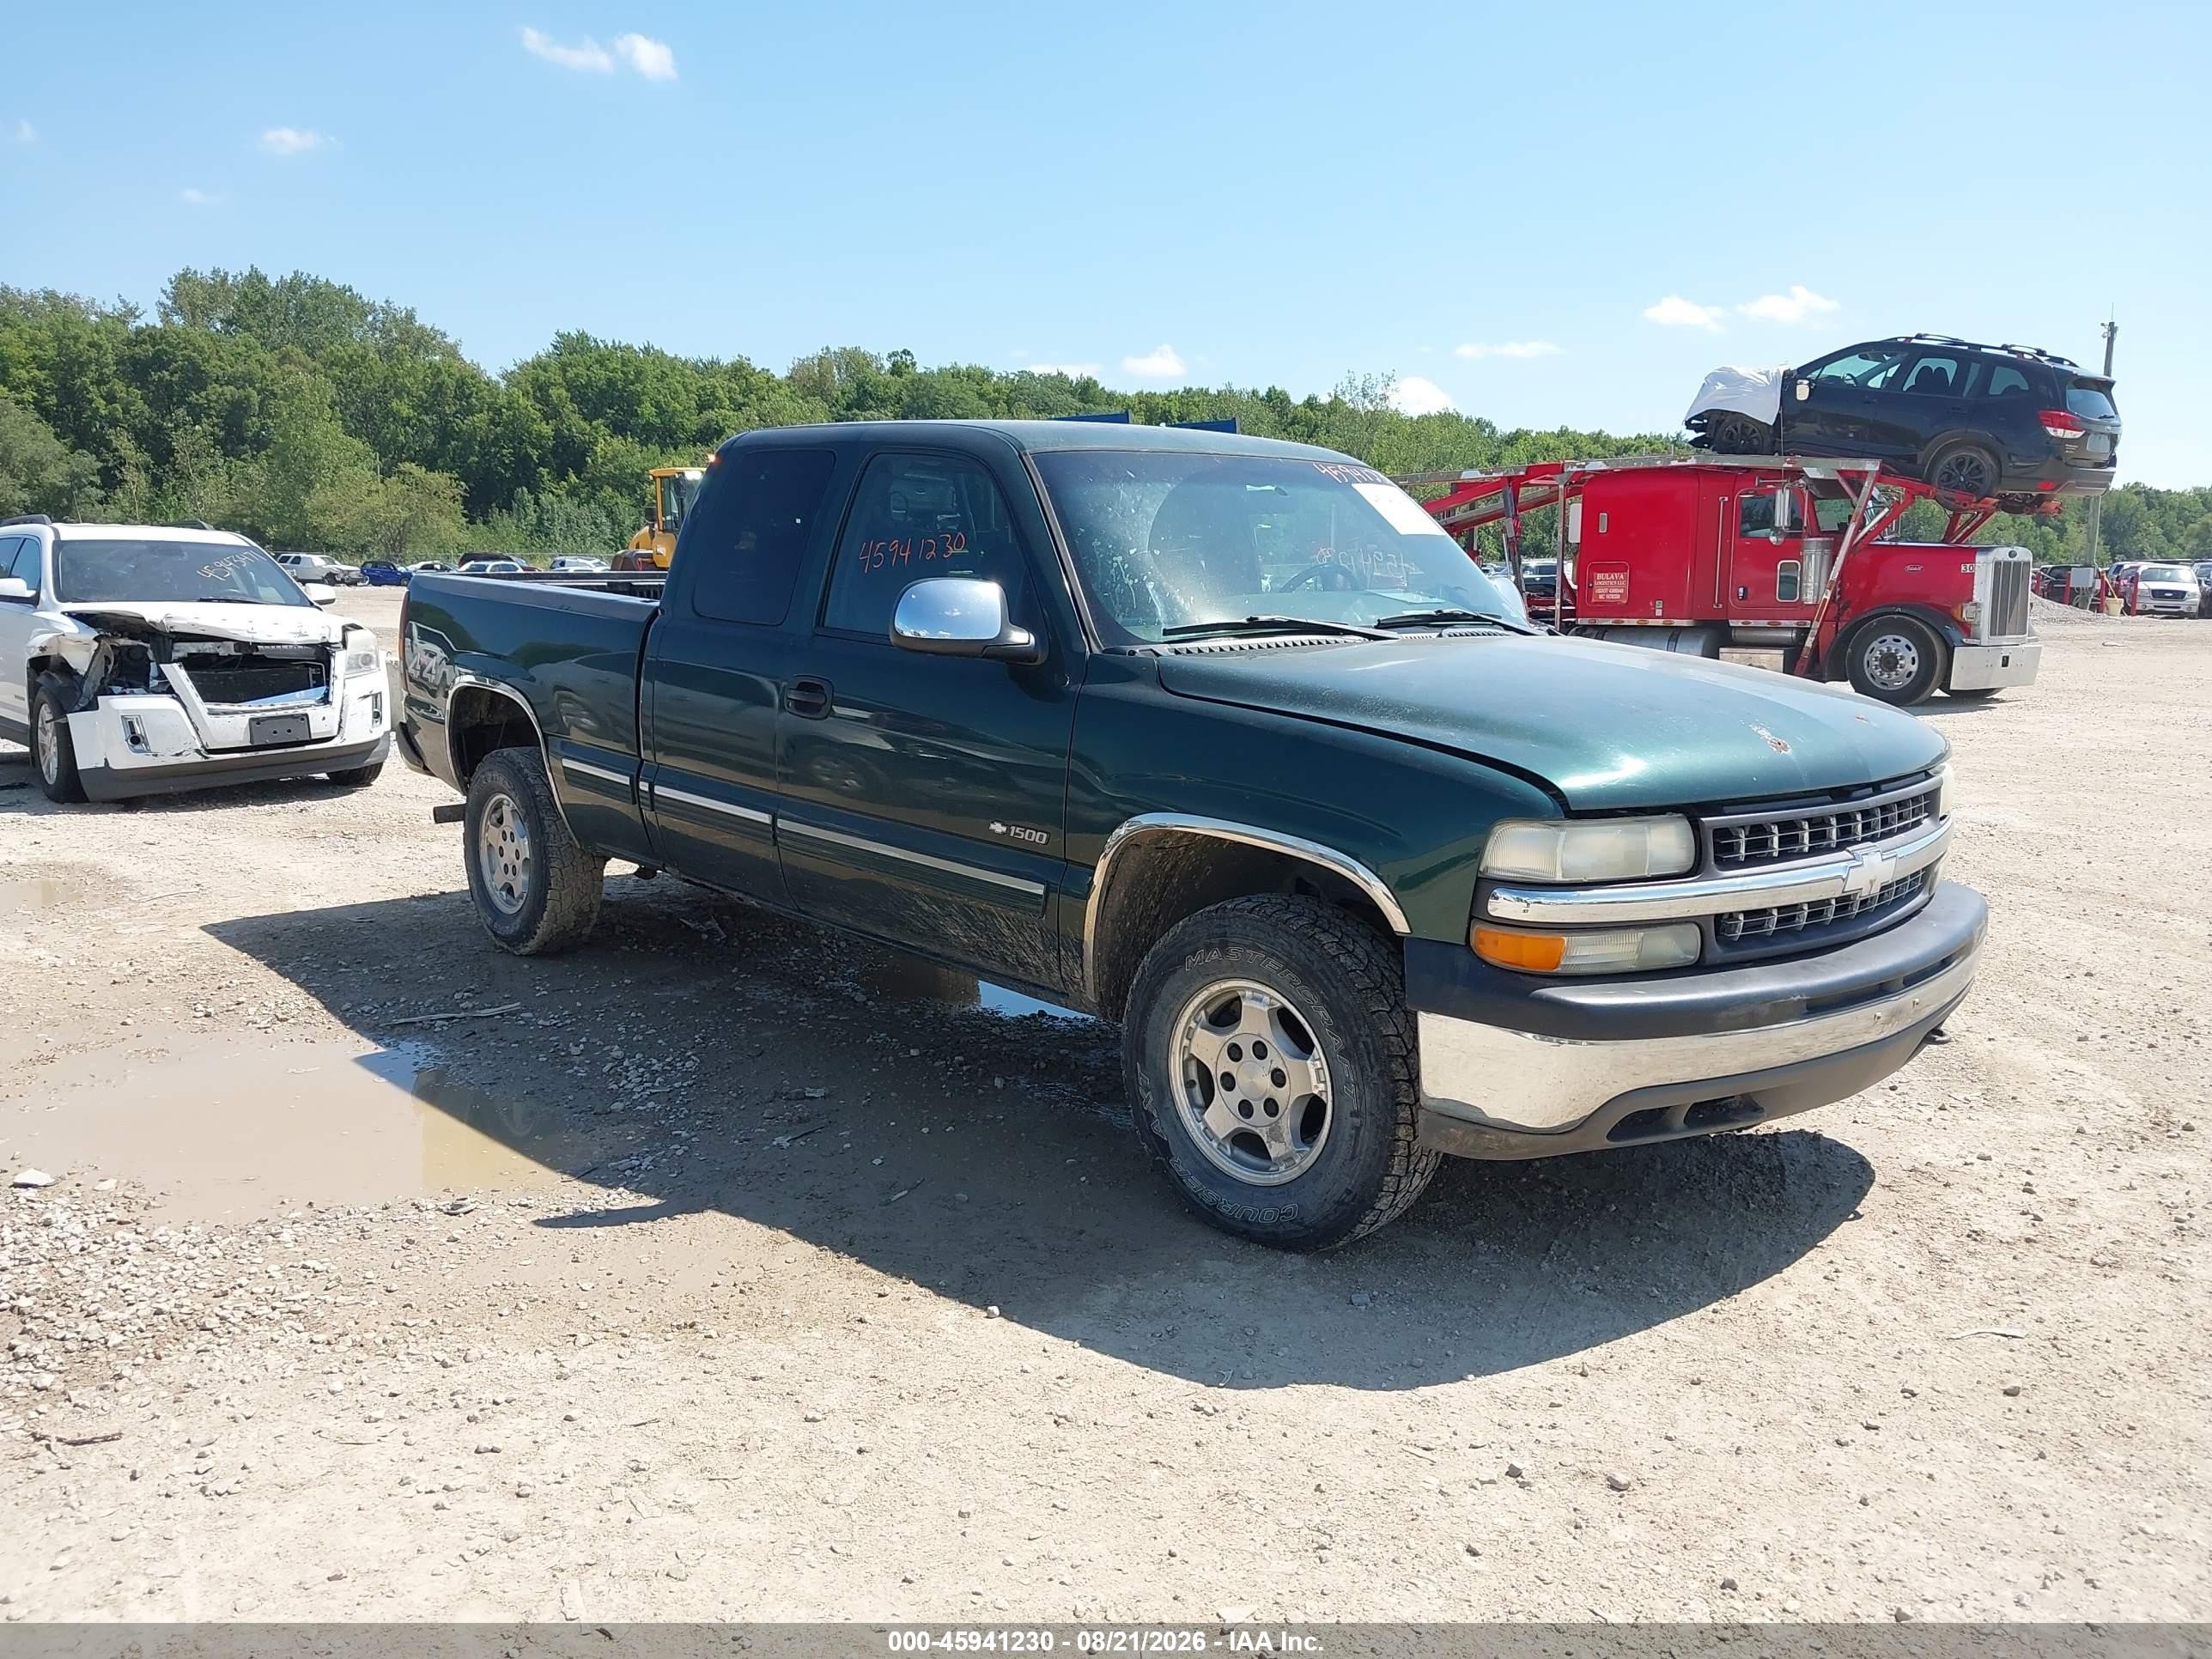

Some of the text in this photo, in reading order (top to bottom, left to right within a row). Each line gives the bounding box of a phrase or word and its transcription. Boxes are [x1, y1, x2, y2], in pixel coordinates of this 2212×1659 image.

[859, 532, 968, 574] 45941230
[1009, 825, 1048, 845] 1500
[1185, 946, 1358, 1110] MASTERCRAFT
[1169, 1157, 1299, 1224] COURSER
